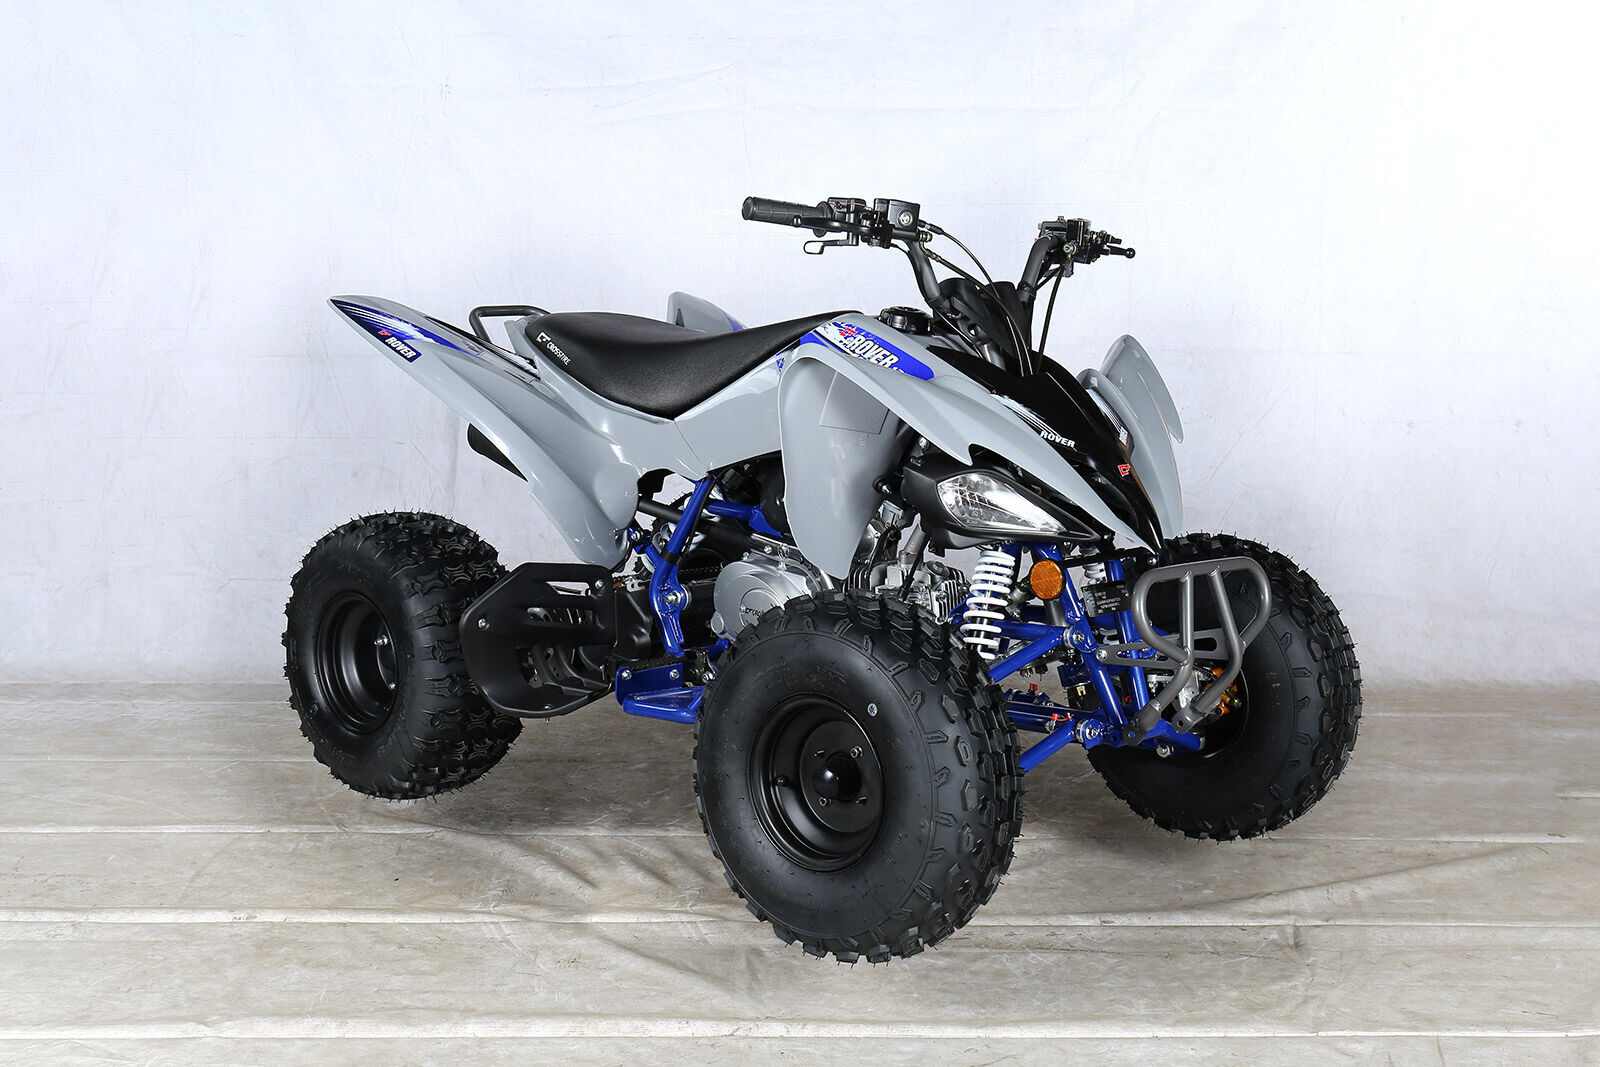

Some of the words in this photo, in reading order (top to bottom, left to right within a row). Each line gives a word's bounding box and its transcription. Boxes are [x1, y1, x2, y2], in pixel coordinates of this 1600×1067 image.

[385, 336, 416, 359] ROVER
[546, 342, 571, 366] CROSSFIRE
[847, 333, 900, 369] ROVER
[1040, 429, 1075, 448] ROVER
